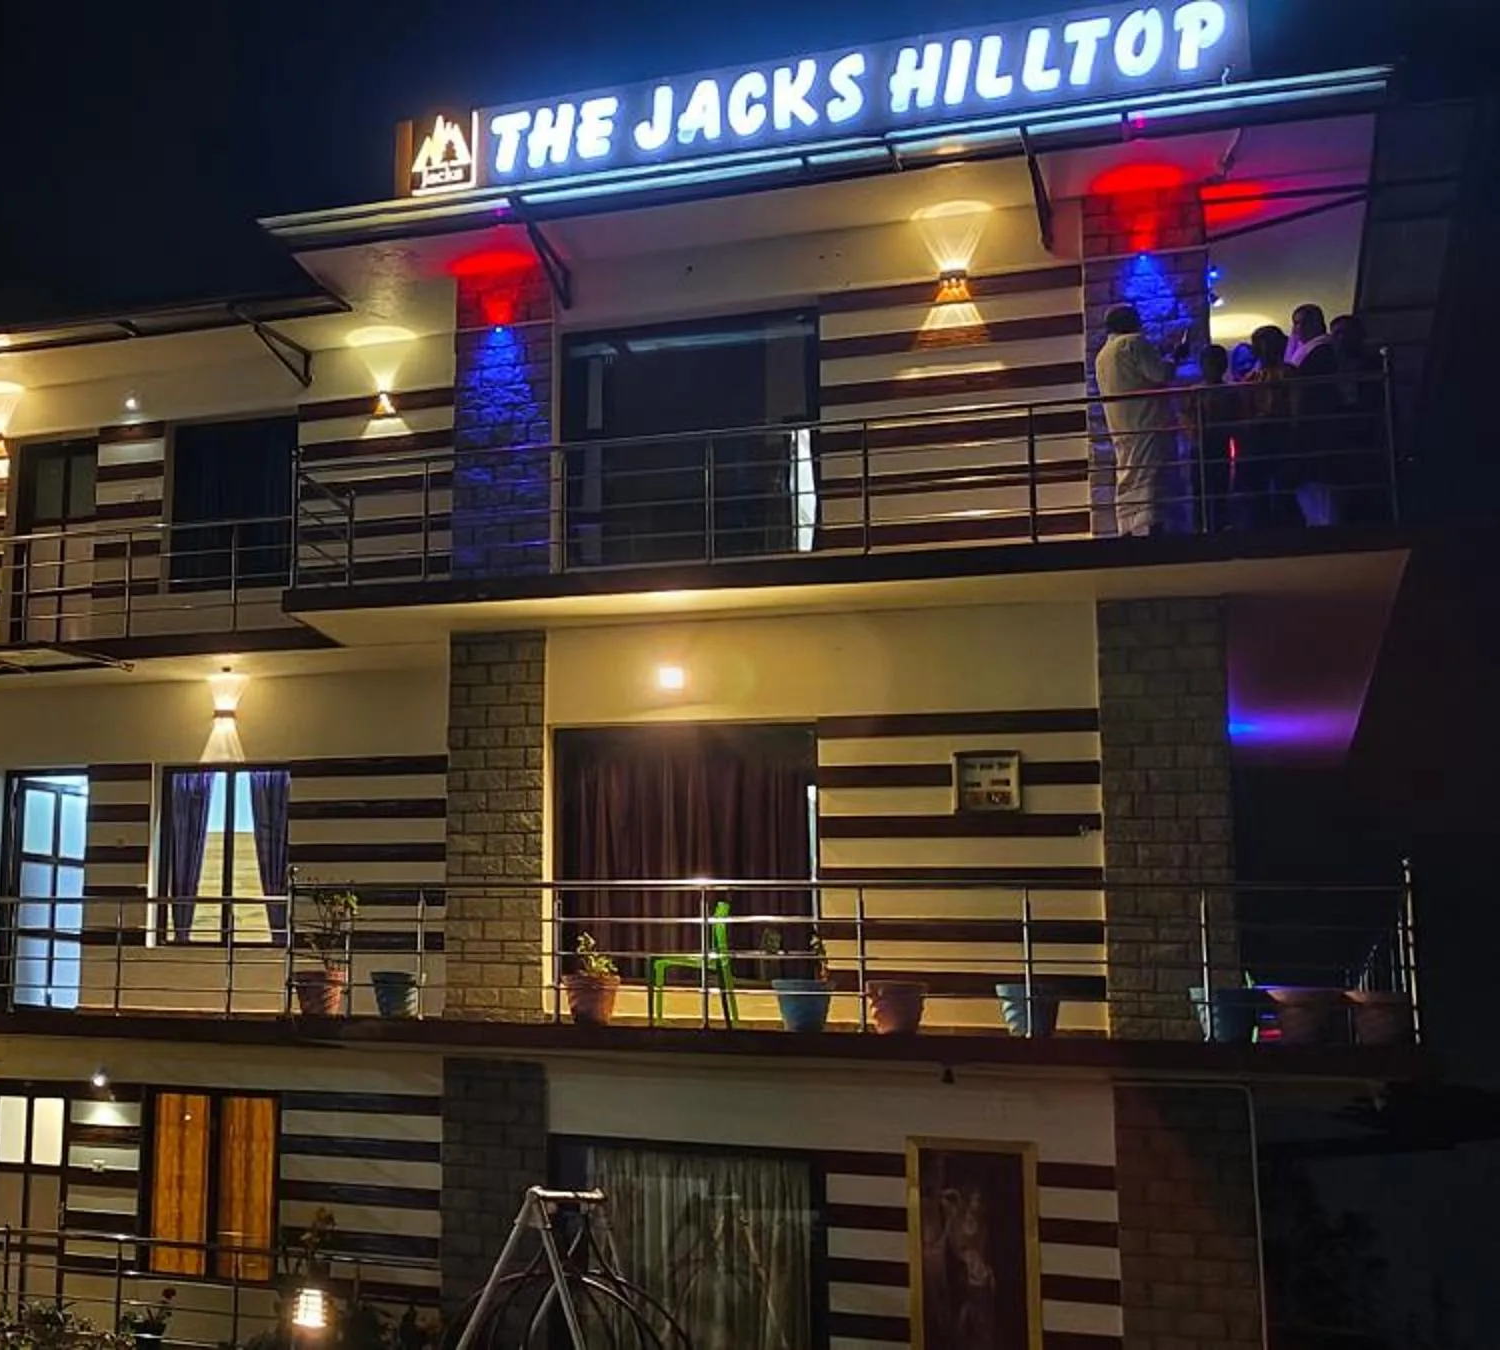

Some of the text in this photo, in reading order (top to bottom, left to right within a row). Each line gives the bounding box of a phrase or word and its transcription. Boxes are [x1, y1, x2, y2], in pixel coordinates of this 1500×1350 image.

[490, 1, 1226, 172] THE JACKS HILLTOP
